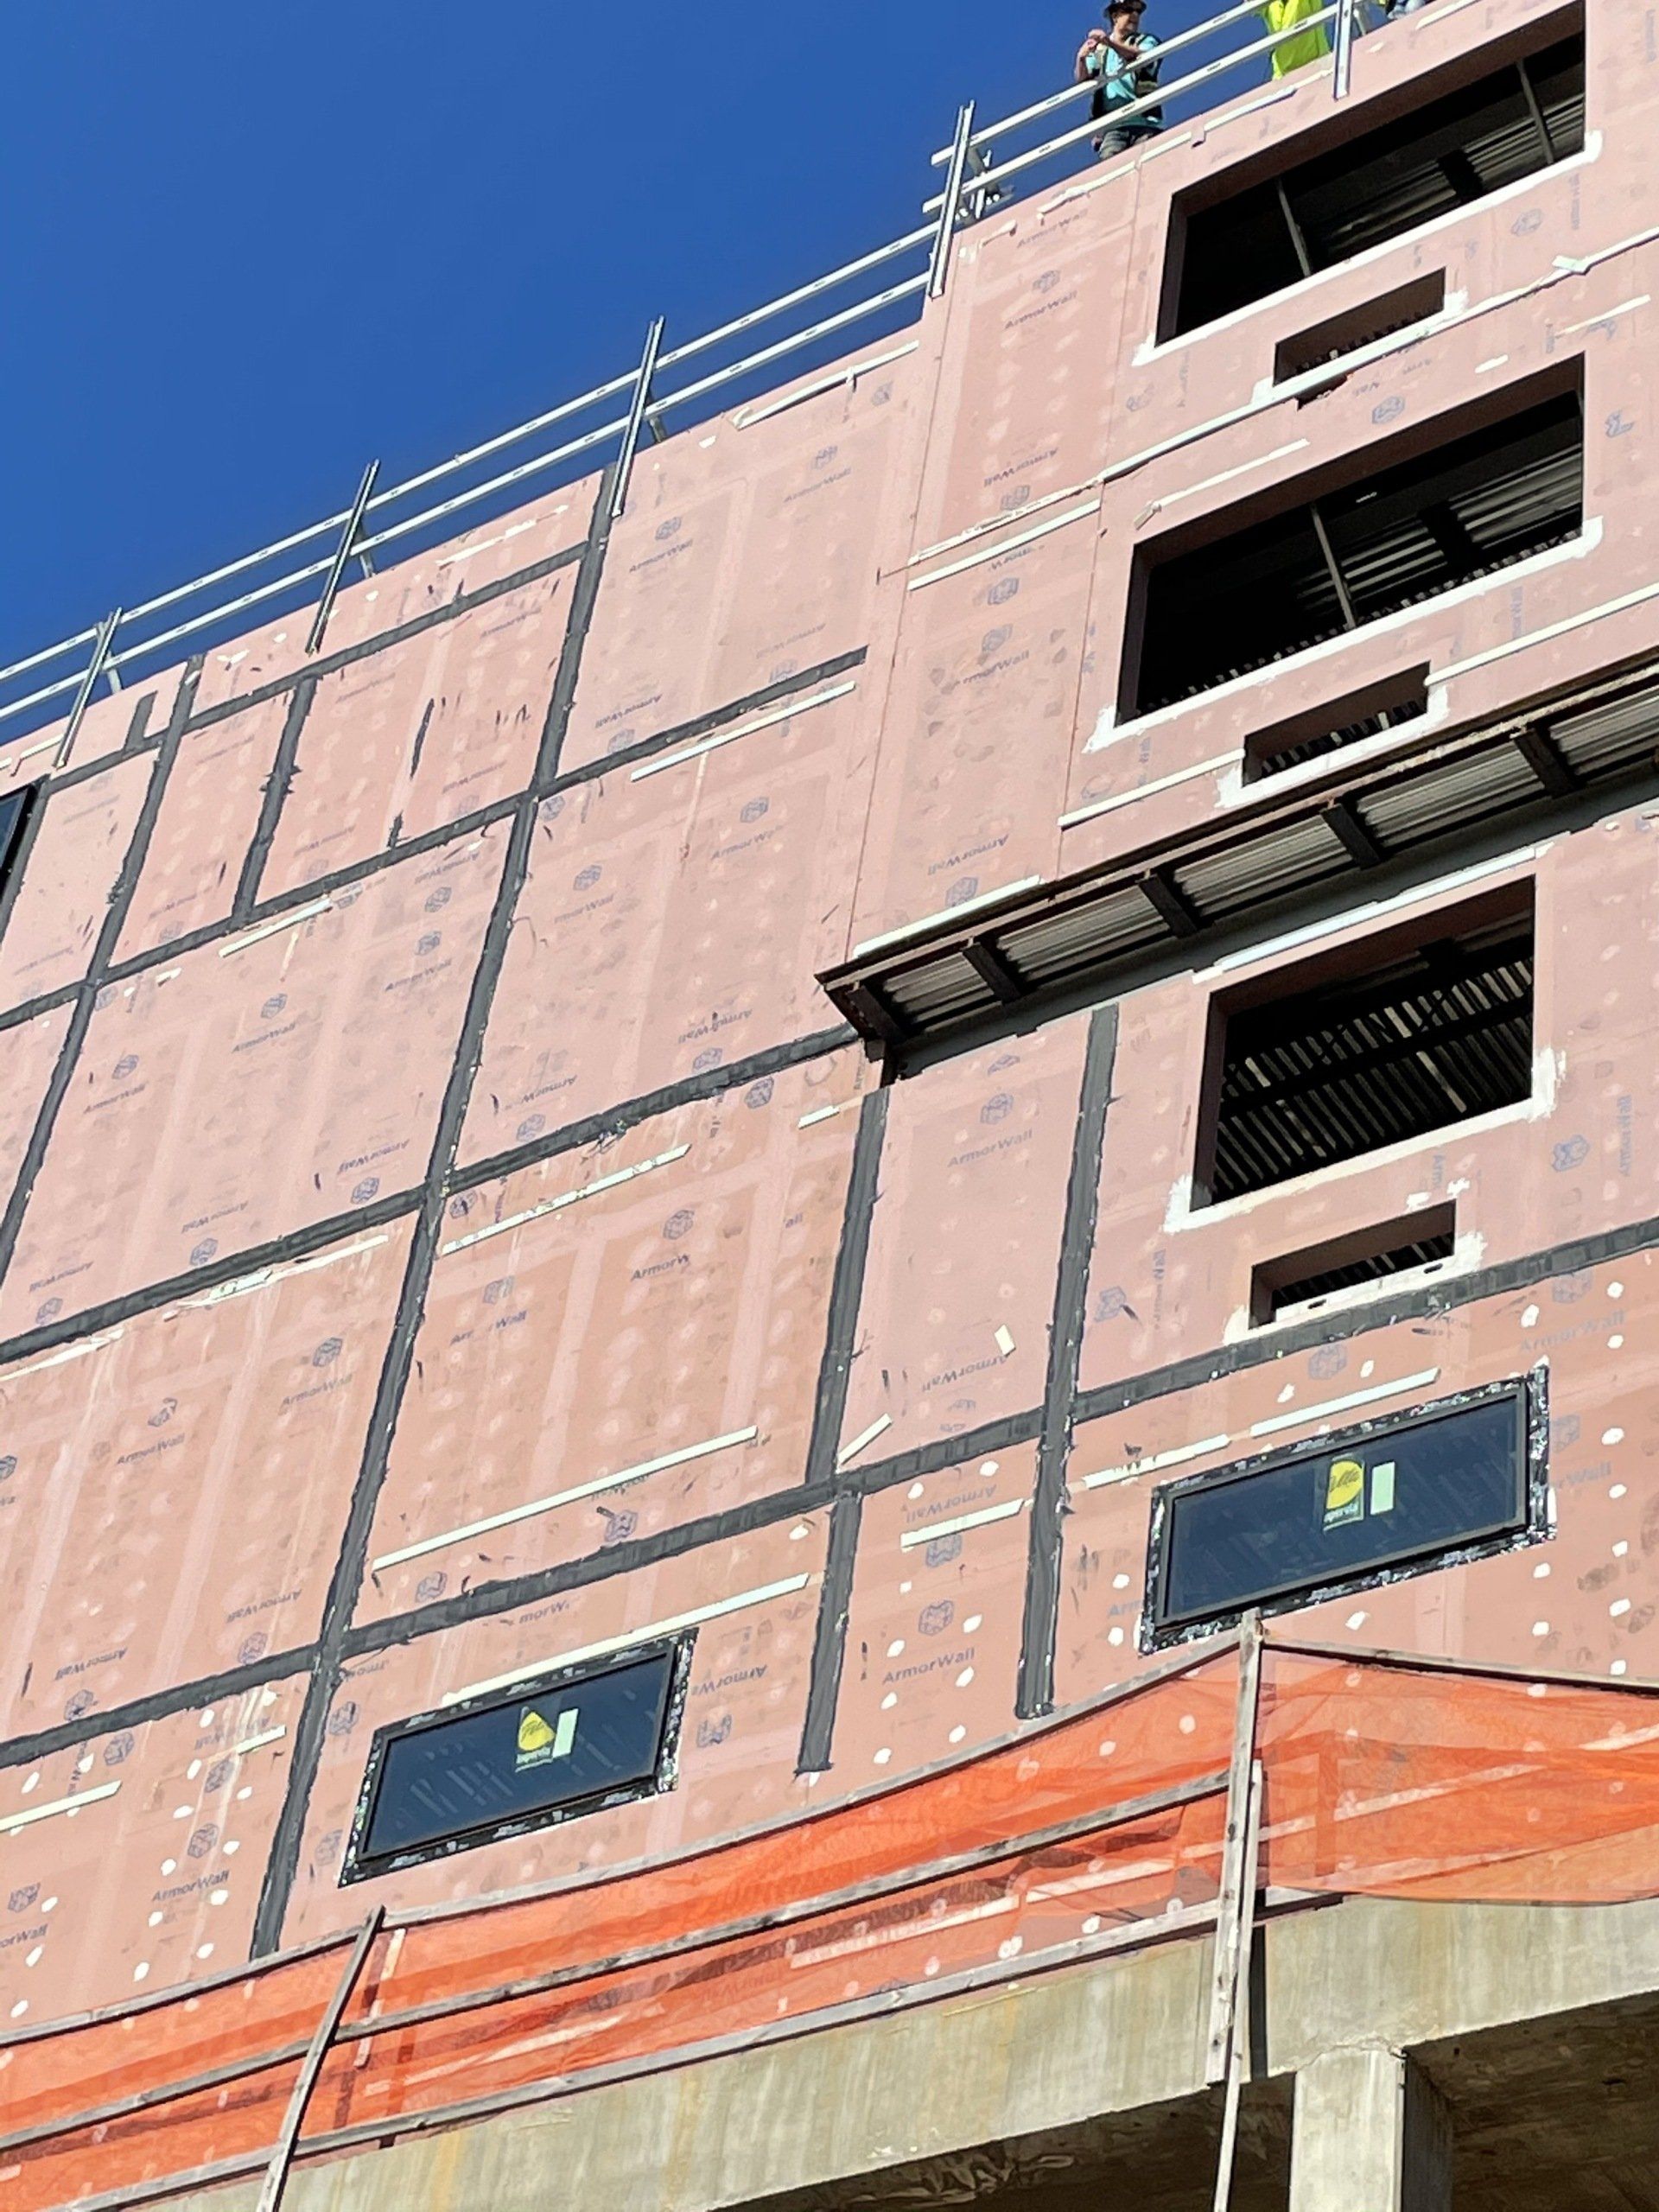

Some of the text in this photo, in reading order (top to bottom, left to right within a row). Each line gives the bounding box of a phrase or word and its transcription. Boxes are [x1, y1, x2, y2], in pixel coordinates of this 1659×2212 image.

[948, 1128, 1033, 1166] ArmorWall
[922, 1355, 1008, 1393] ArmorWall
[910, 1484, 997, 1523] ArmorWall
[883, 1648, 975, 1684] ArmorWall
[153, 1870, 229, 1901] ArmorWall
